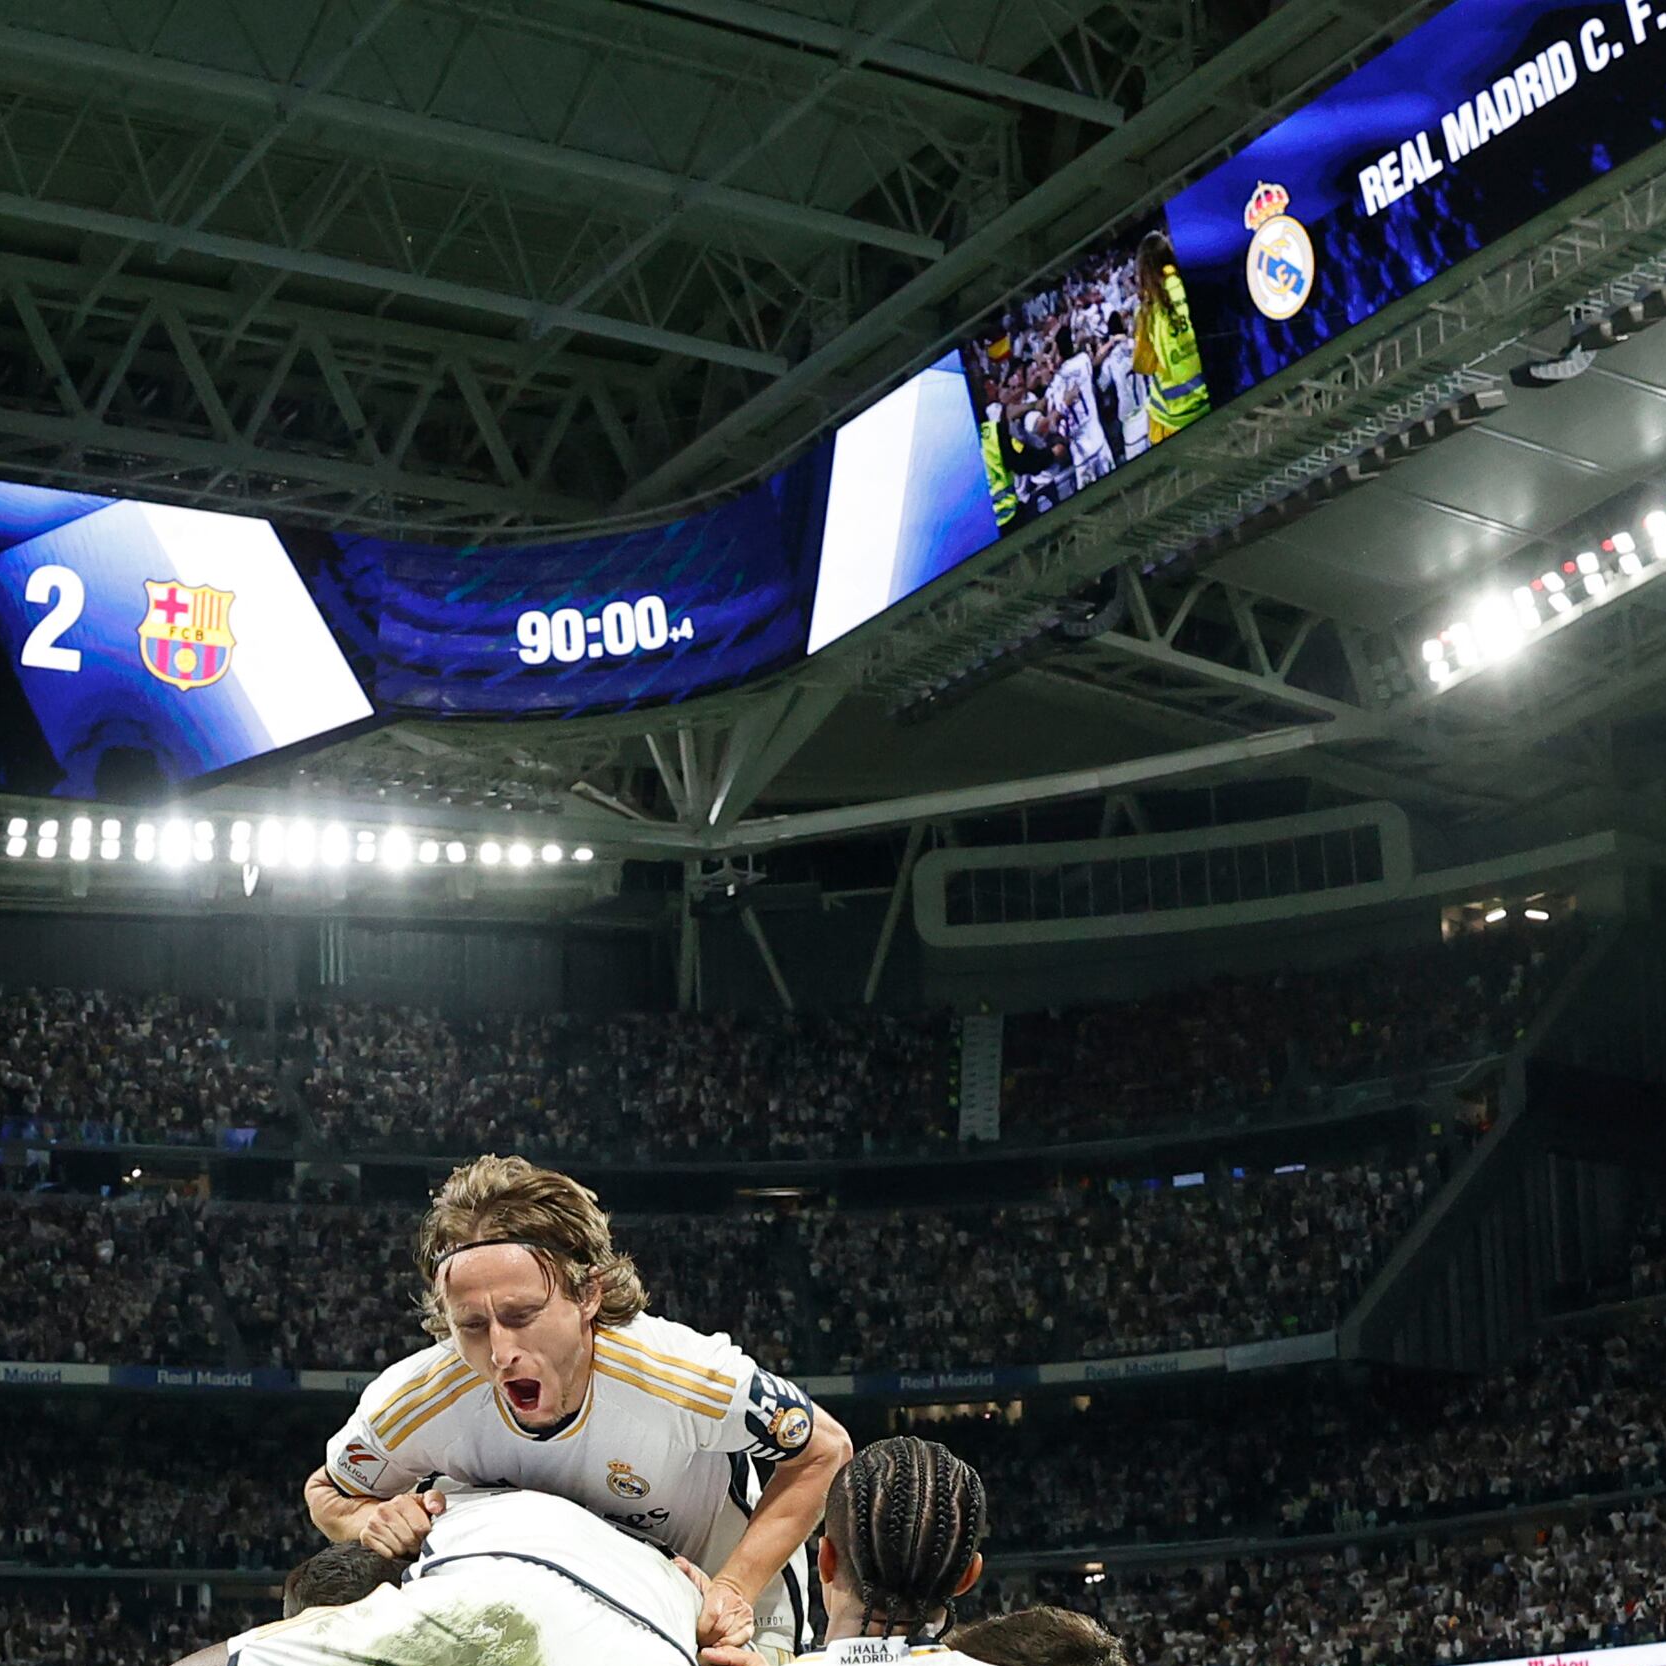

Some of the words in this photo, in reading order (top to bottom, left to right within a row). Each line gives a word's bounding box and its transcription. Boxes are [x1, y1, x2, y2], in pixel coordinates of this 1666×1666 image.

[1358, 131, 1443, 216] REAL
[1441, 40, 1577, 162] MADRID
[1579, 17, 1624, 73] C.
[21, 564, 85, 673] 2
[517, 595, 666, 664] 90:00
[669, 616, 694, 644] +4
[4, 1367, 61, 1383] Madrid
[157, 1370, 193, 1386] Real
[198, 1371, 252, 1387] Madrid
[1085, 1363, 1121, 1379] Real
[1125, 1359, 1179, 1376] Madrid
[900, 1374, 935, 1390] Real
[939, 1372, 994, 1389] Madrid
[337, 1457, 368, 1482] LALIGA
